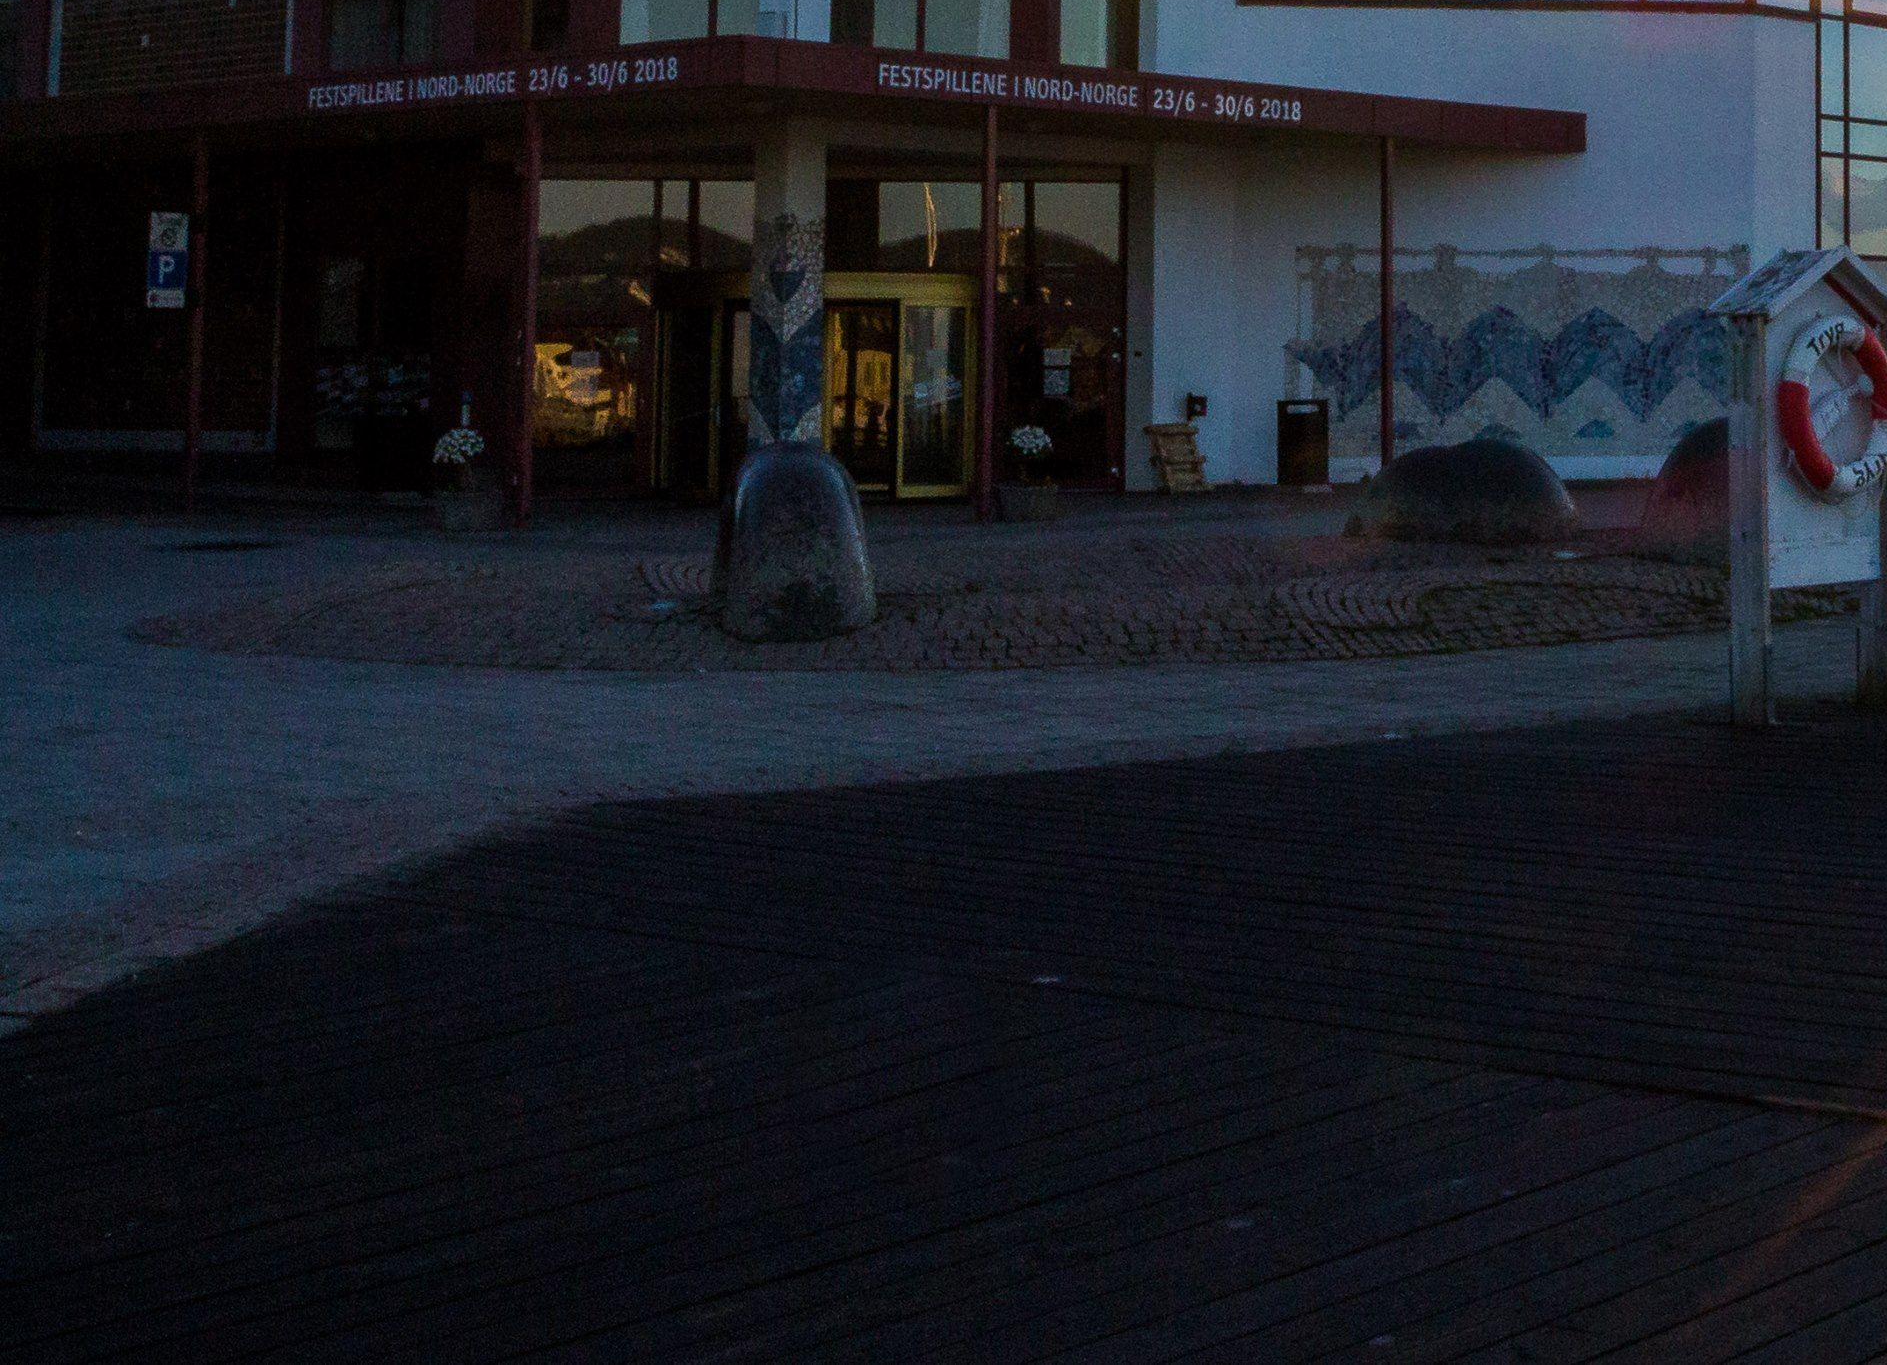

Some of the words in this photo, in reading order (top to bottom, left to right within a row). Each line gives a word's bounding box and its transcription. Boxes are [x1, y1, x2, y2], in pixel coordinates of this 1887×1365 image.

[308, 80, 404, 109] FESTSPILLENE
[416, 70, 517, 98] NORD-NORGE
[528, 65, 569, 98] 23/6
[587, 60, 629, 92] 30/6
[634, 56, 679, 83] 2018
[877, 63, 1007, 96] FESTSPILLENE
[1023, 76, 1138, 108] NORD-NORGE
[1152, 88, 1196, 117] 23/6
[1214, 94, 1255, 122] 30/6
[1259, 97, 1303, 123] 2018
[158, 254, 176, 285] P
